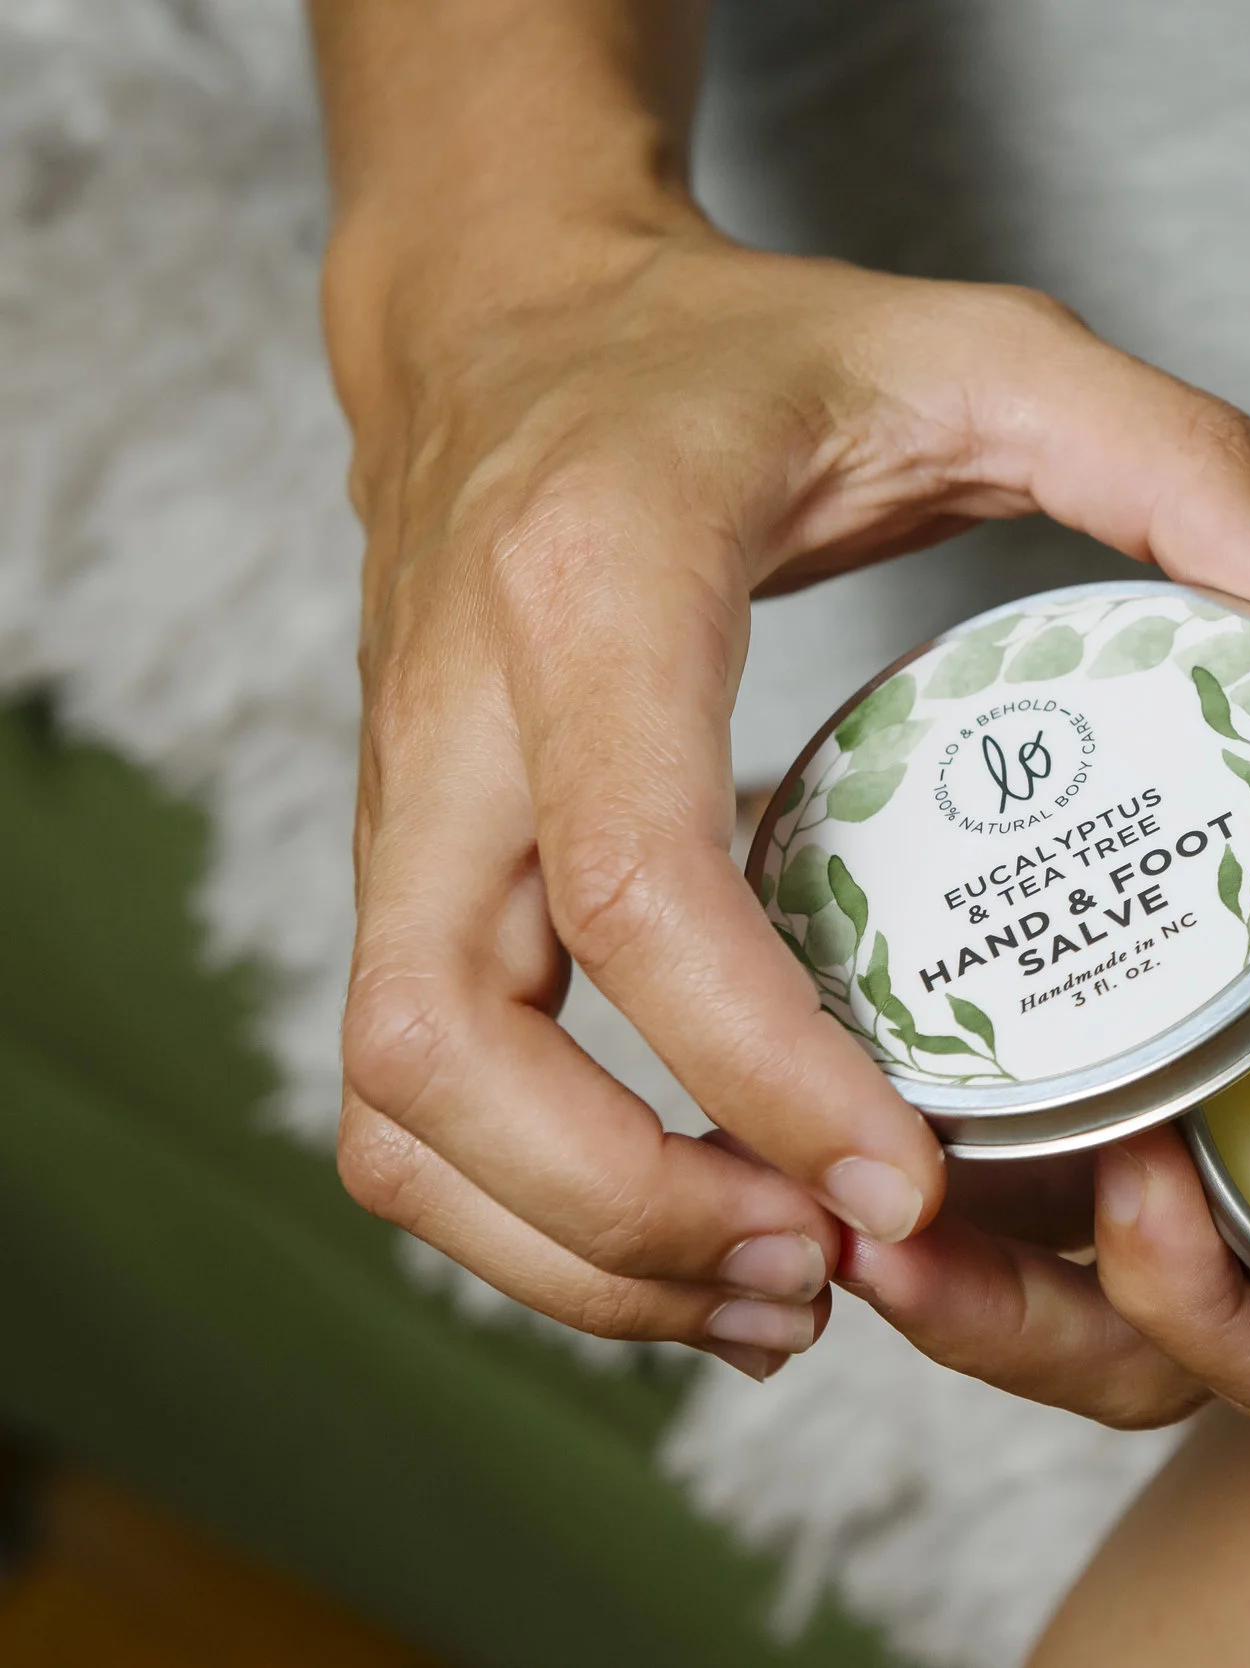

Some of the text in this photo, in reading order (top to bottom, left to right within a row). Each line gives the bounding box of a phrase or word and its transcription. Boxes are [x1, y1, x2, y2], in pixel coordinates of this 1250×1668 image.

[934, 713, 1096, 835] 100% NATURAL BODY CARE
[960, 727, 974, 740] &
[918, 811, 1233, 993] HAND & FOOT
[944, 788, 1162, 910] EUCALYPTUS
[968, 814, 1160, 924] & TEA TREE
[1018, 884, 1169, 976] SALVE
[1020, 912, 1197, 1015] Handmade in NC
[1071, 961, 1161, 1007] 3 fl. oz.
